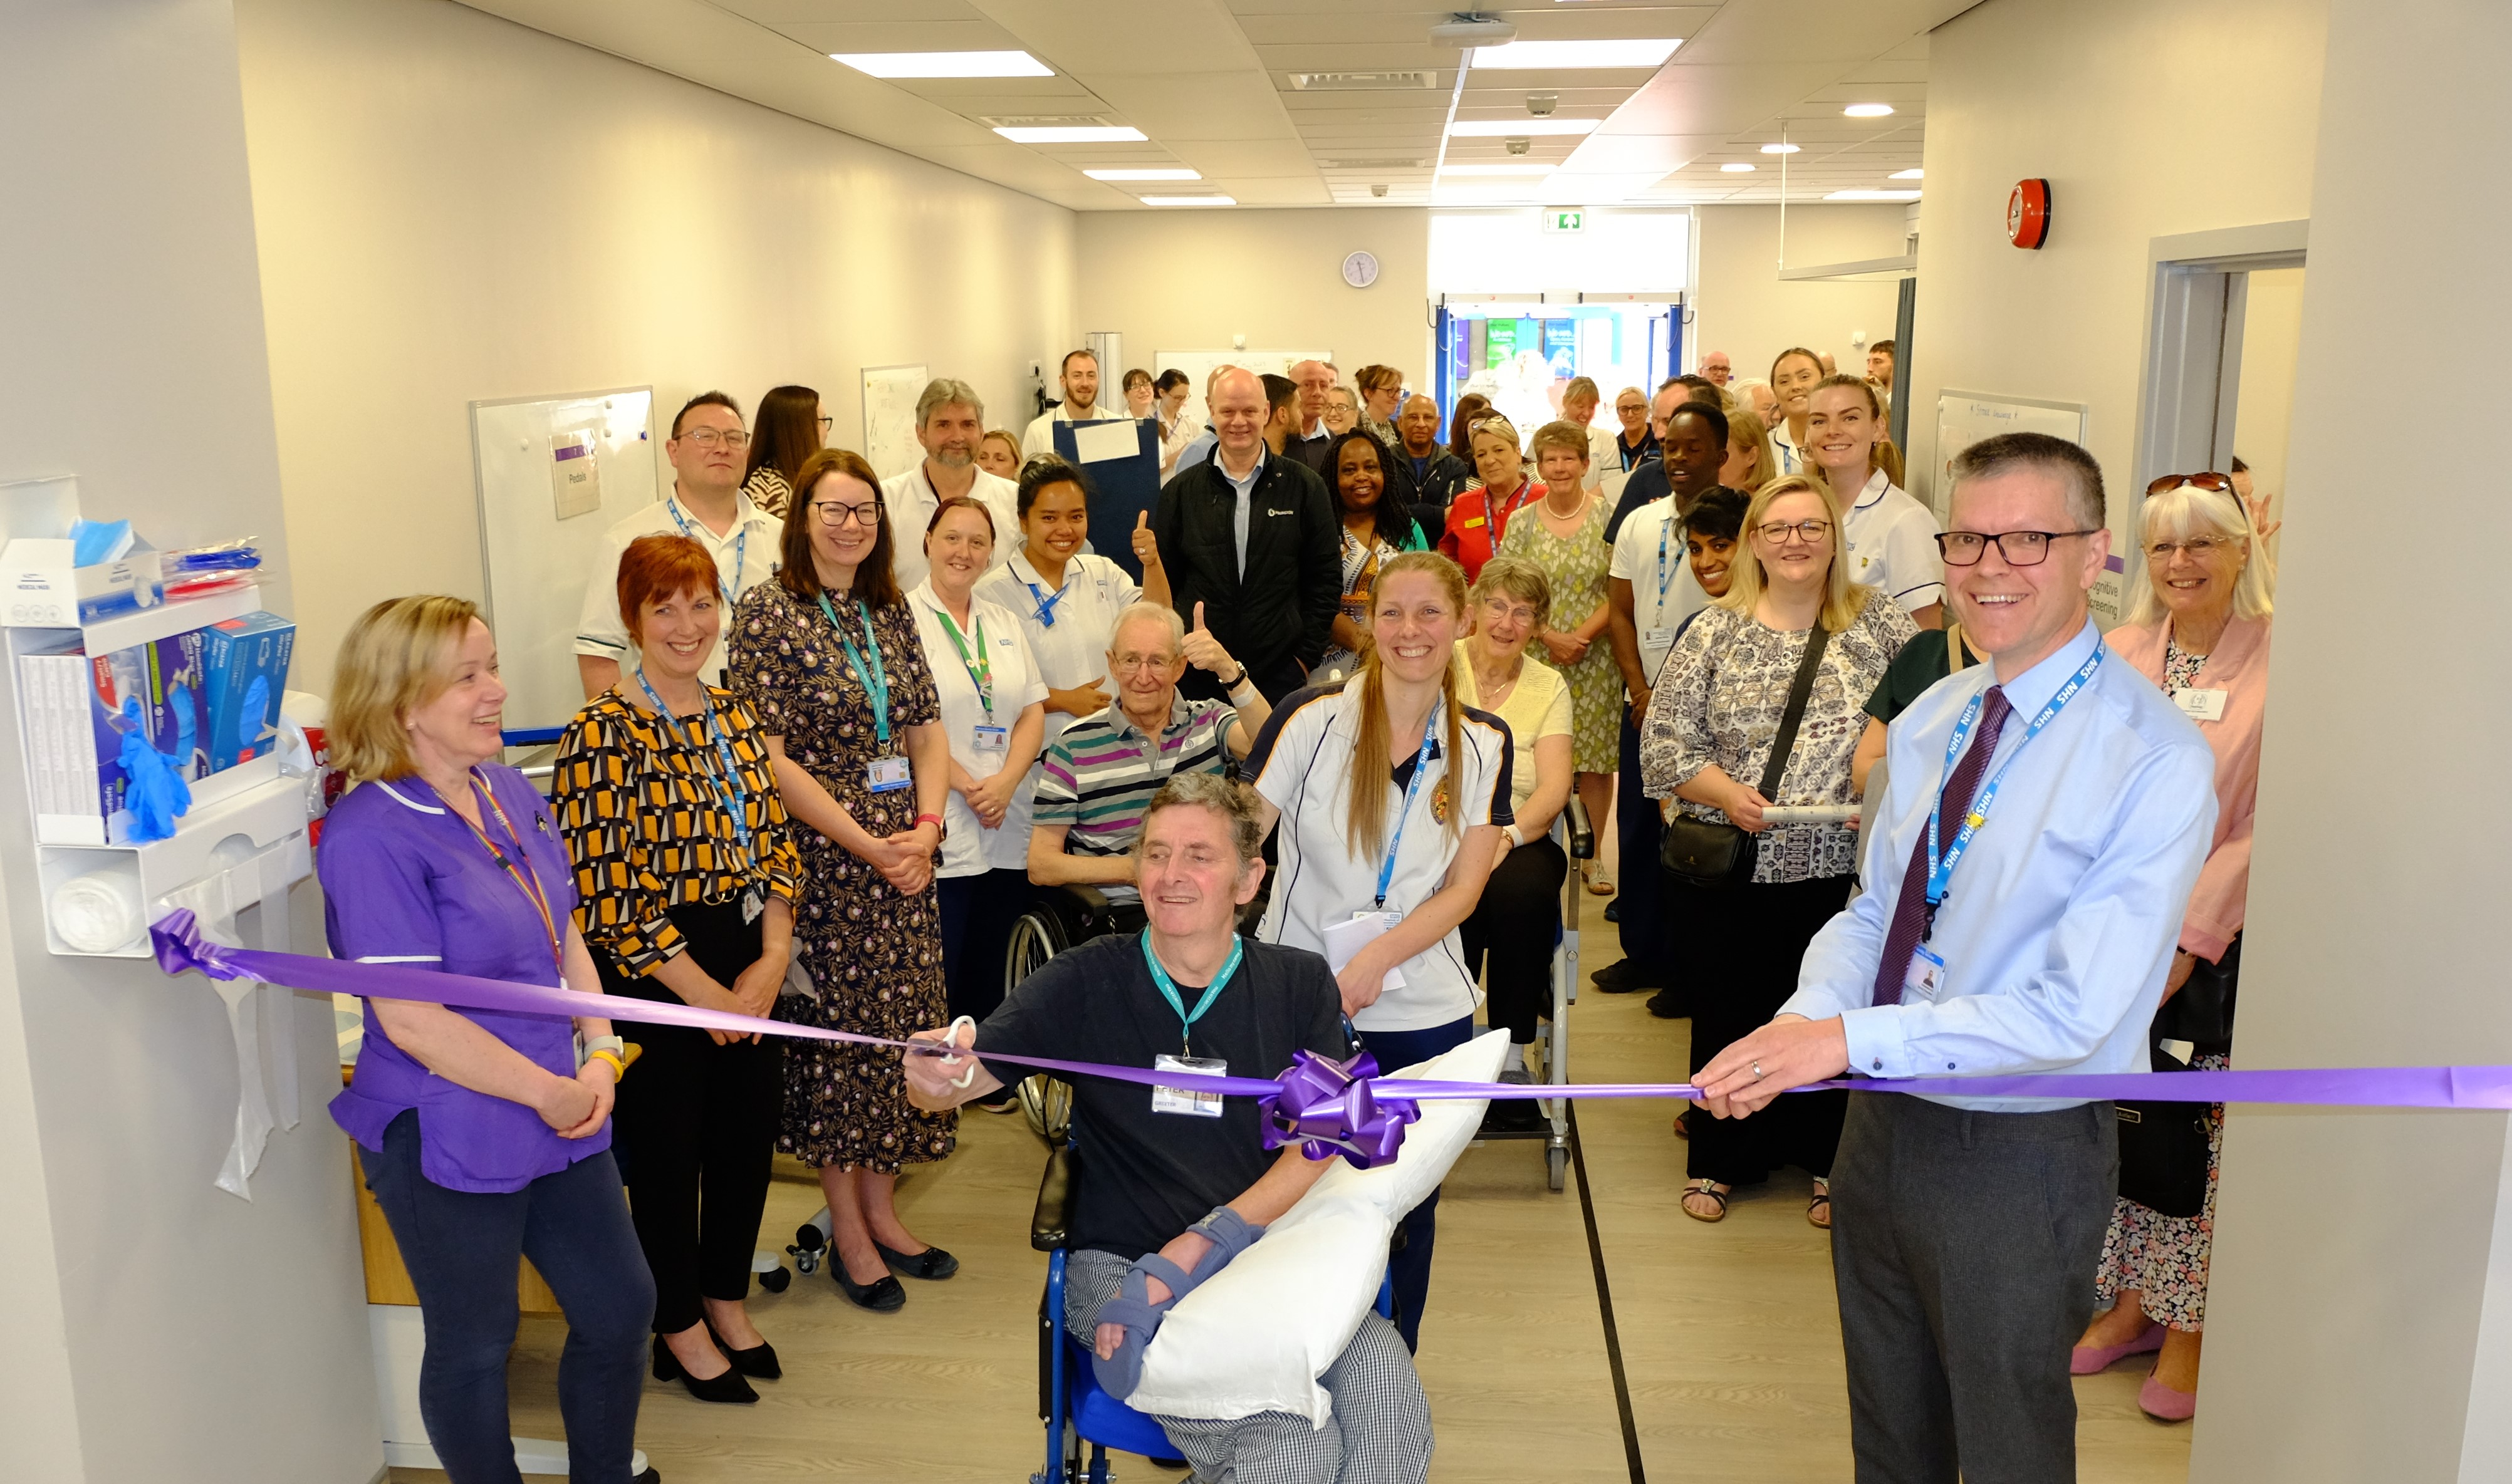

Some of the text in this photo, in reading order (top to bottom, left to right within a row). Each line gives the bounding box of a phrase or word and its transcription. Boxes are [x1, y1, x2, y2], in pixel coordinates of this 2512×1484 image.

[569, 472, 586, 484] Pedals
[2090, 581, 2118, 597] ognitive
[2080, 658, 2098, 679] NHS
[648, 692, 662, 707] NHS
[2057, 682, 2078, 704] NHS
[2035, 707, 2054, 729] NHS
[1949, 703, 1976, 754] NHS NHS
[717, 739, 728, 753] NHS
[724, 758, 735, 773] NHS
[1419, 747, 1429, 765] NHS
[1413, 771, 1422, 788] NHS
[1976, 792, 1993, 817] NHS
[731, 810, 748, 846] NHS NHS
[1390, 839, 1398, 856] NHS
[1944, 847, 1961, 871] NHS
[1229, 961, 1236, 970] my
[1232, 952, 1241, 963] name
[1221, 967, 1231, 979] Hello
